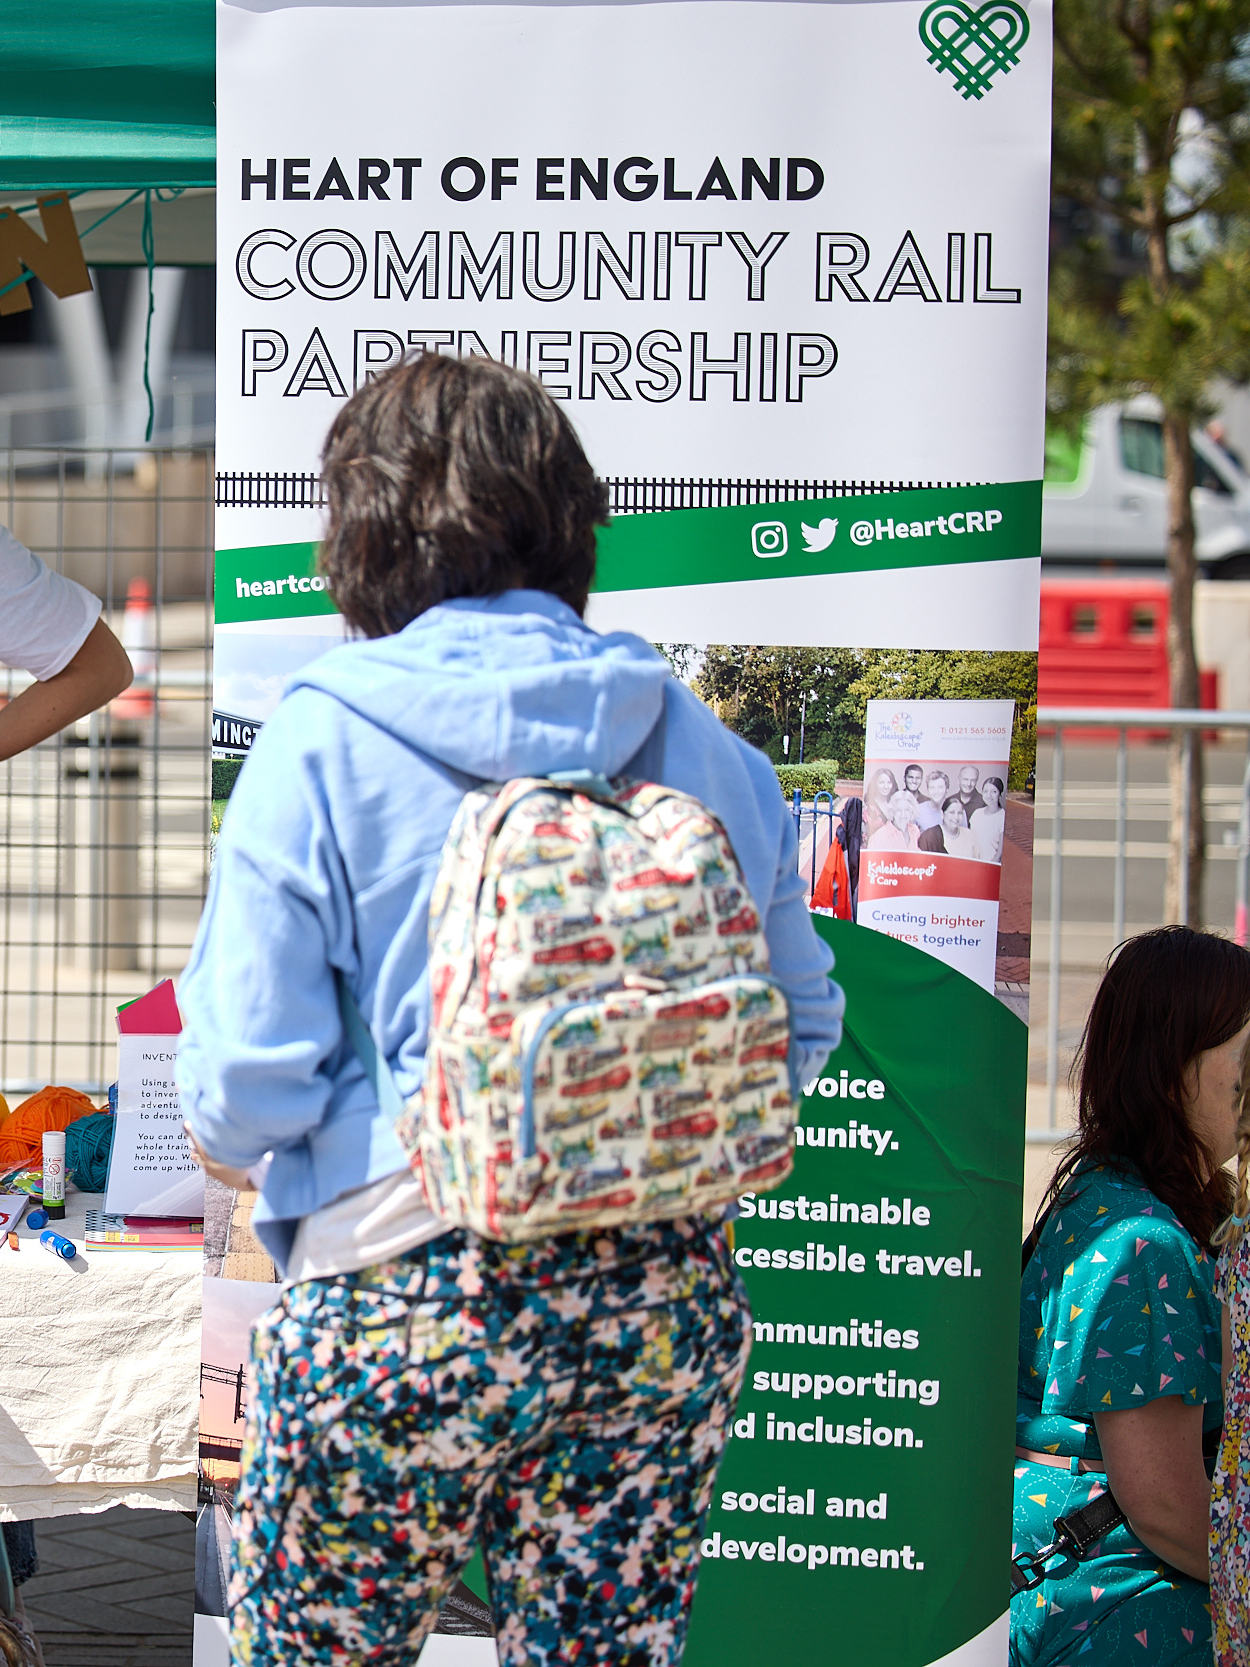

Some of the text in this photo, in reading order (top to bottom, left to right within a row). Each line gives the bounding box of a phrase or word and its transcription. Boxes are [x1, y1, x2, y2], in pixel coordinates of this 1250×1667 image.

[241, 156, 825, 202] HEART OF ENGLAND
[235, 228, 1022, 303] COMMUNITY RAIL
[849, 510, 1003, 545] @HeartCRP
[877, 722, 891, 732] The
[897, 740, 921, 750] Group
[877, 876, 899, 886] Care
[871, 910, 986, 929] Creating brighter
[922, 934, 982, 947] together
[141, 1078, 168, 1088] Using
[153, 1112, 183, 1121] design
[134, 1153, 155, 1162] help
[158, 1155, 178, 1163] you.
[161, 1165, 173, 1173] up
[738, 1191, 931, 1226] Sustainable
[875, 1249, 982, 1277] travel.
[752, 1370, 941, 1406] supporting
[766, 1412, 924, 1448] inclusion.
[721, 1486, 888, 1520] social and
[700, 1531, 925, 1570] development.
